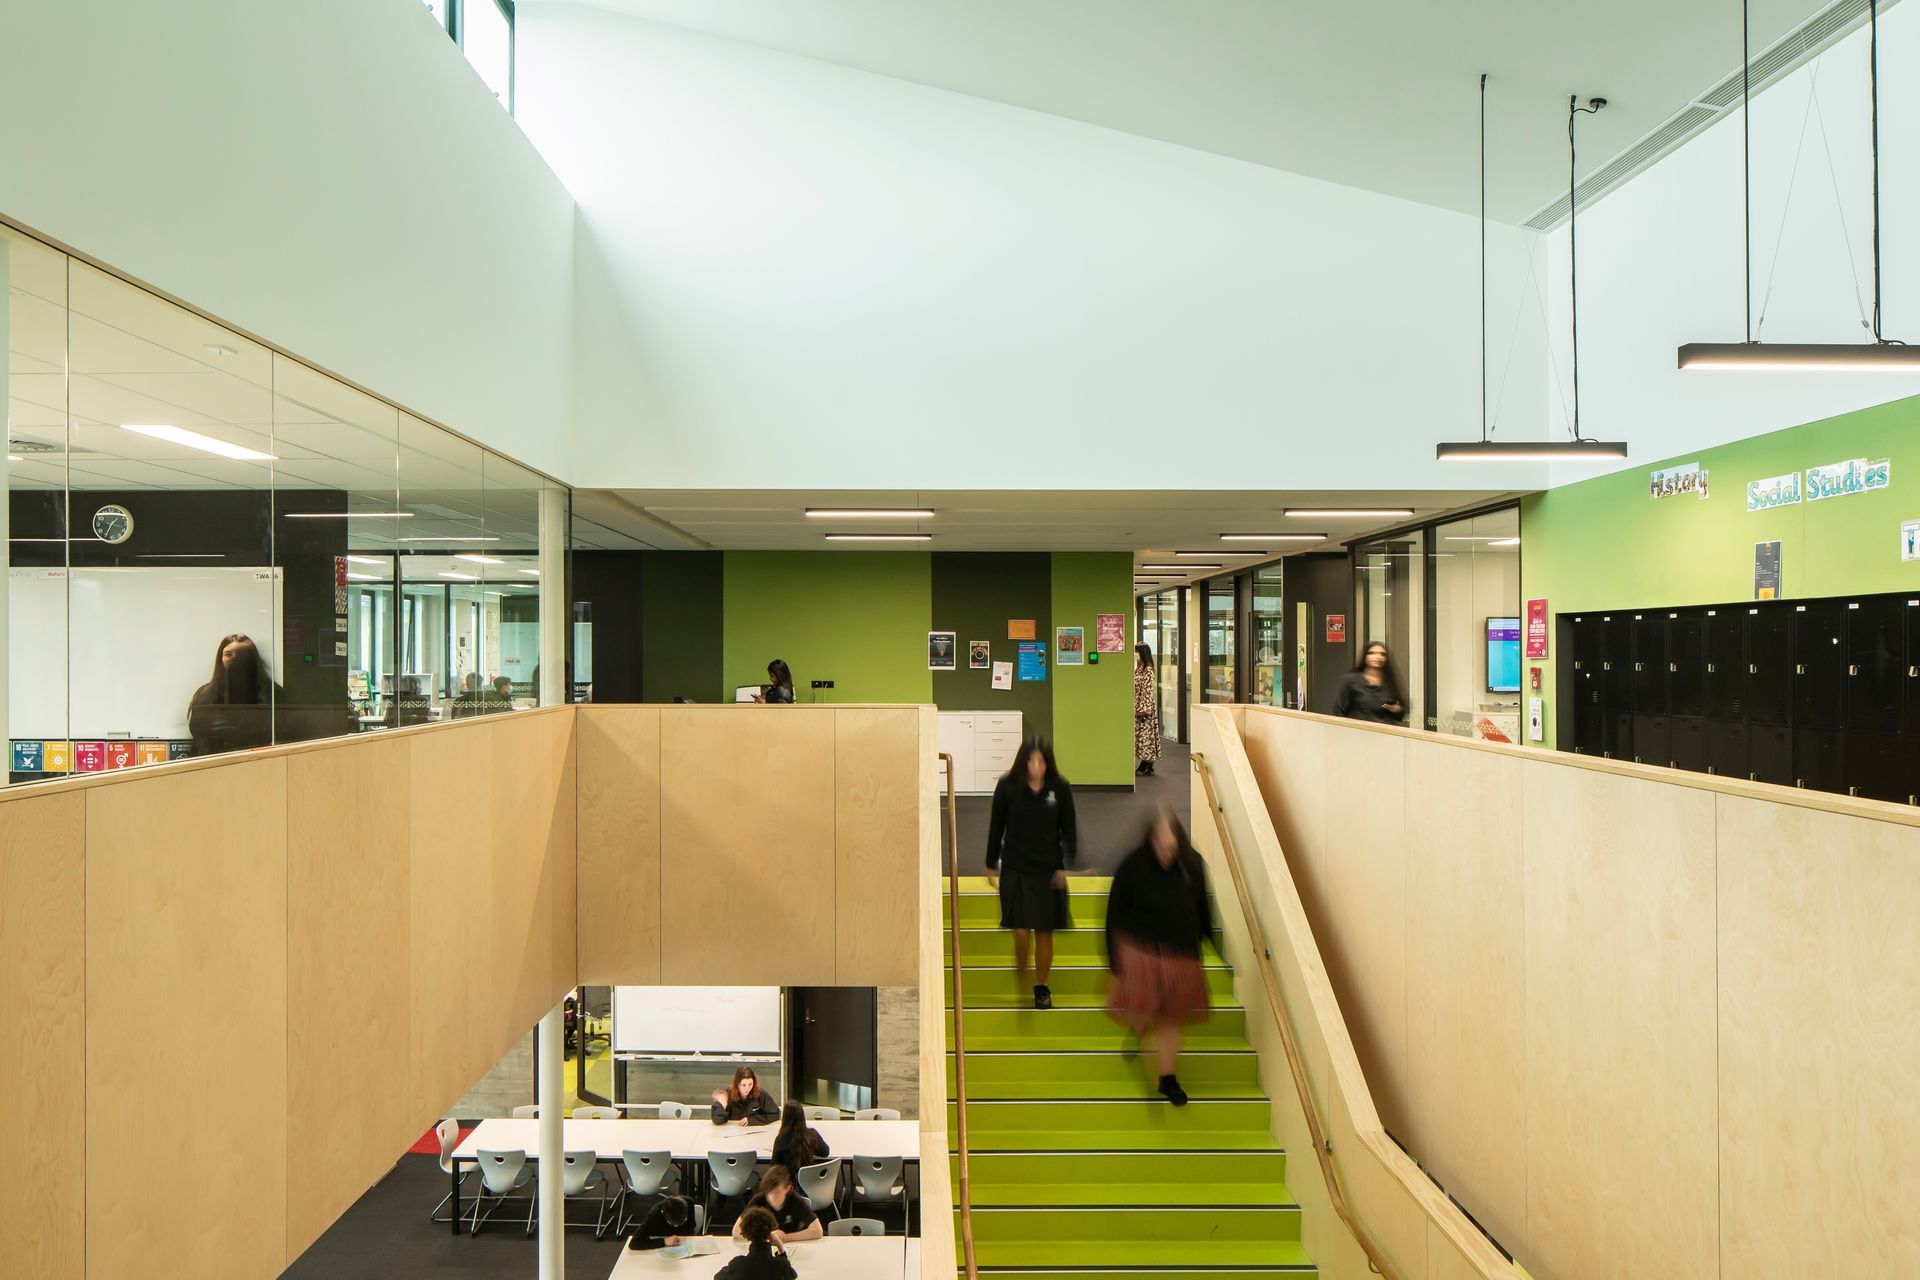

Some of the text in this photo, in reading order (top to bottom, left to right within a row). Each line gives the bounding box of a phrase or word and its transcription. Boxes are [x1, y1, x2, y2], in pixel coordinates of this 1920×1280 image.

[1650, 471, 1708, 498] History
[1748, 461, 1888, 509] Social Studies
[1903, 523, 1920, 558] T
